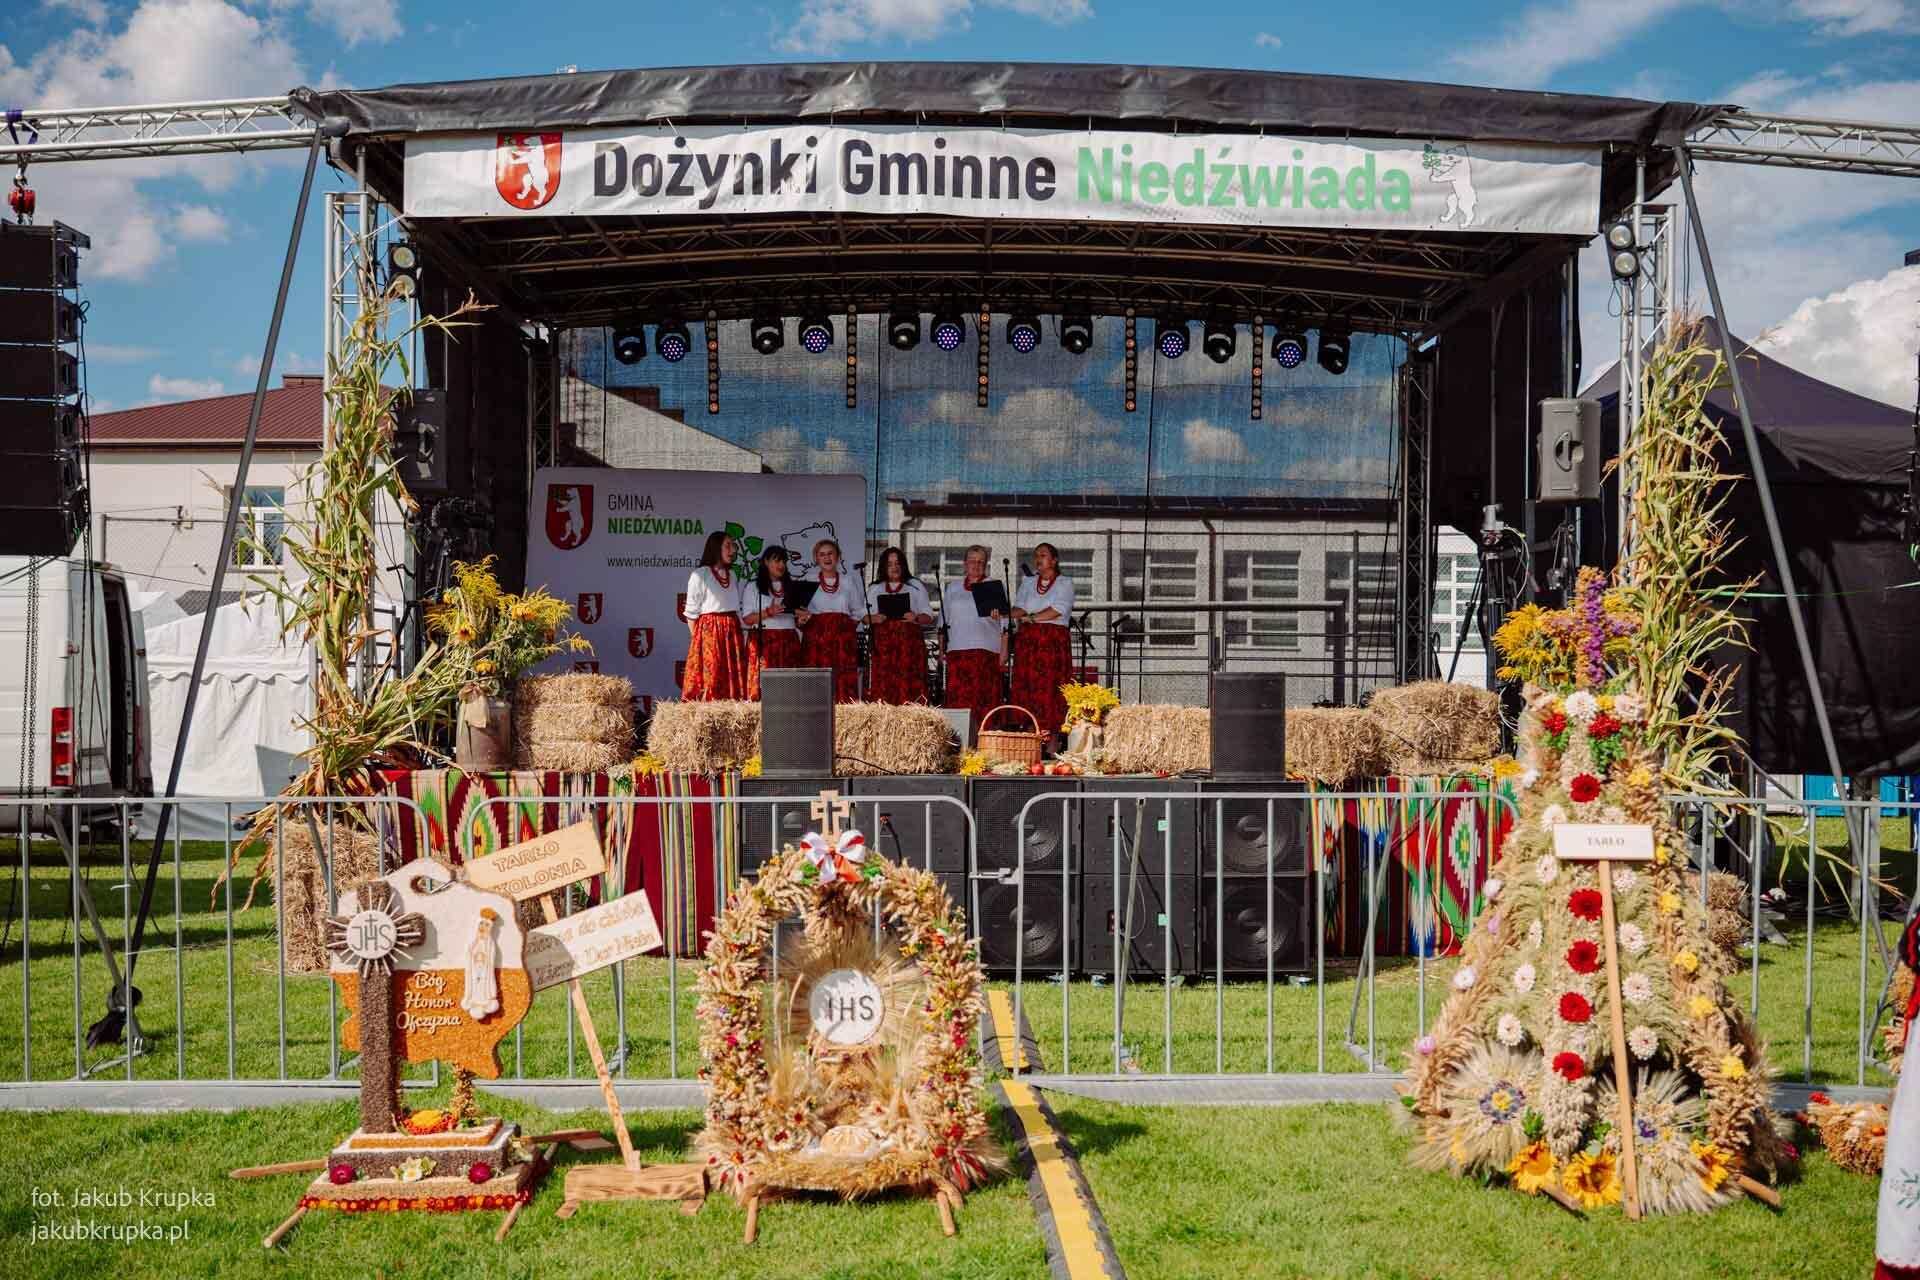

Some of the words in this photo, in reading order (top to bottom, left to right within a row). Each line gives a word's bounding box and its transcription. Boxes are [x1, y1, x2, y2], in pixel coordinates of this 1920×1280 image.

[593, 136, 818, 210] Dożynki
[840, 137, 1056, 201] Gminne
[1076, 143, 1412, 213] Niedźwiada
[607, 494, 654, 511] GMINA
[607, 514, 704, 535] NIEDŹWIADA
[607, 554, 702, 569] www.niedzwiada.p
[414, 971, 447, 993] Bóg
[404, 991, 454, 1009] Honor
[828, 995, 874, 1021] IHS
